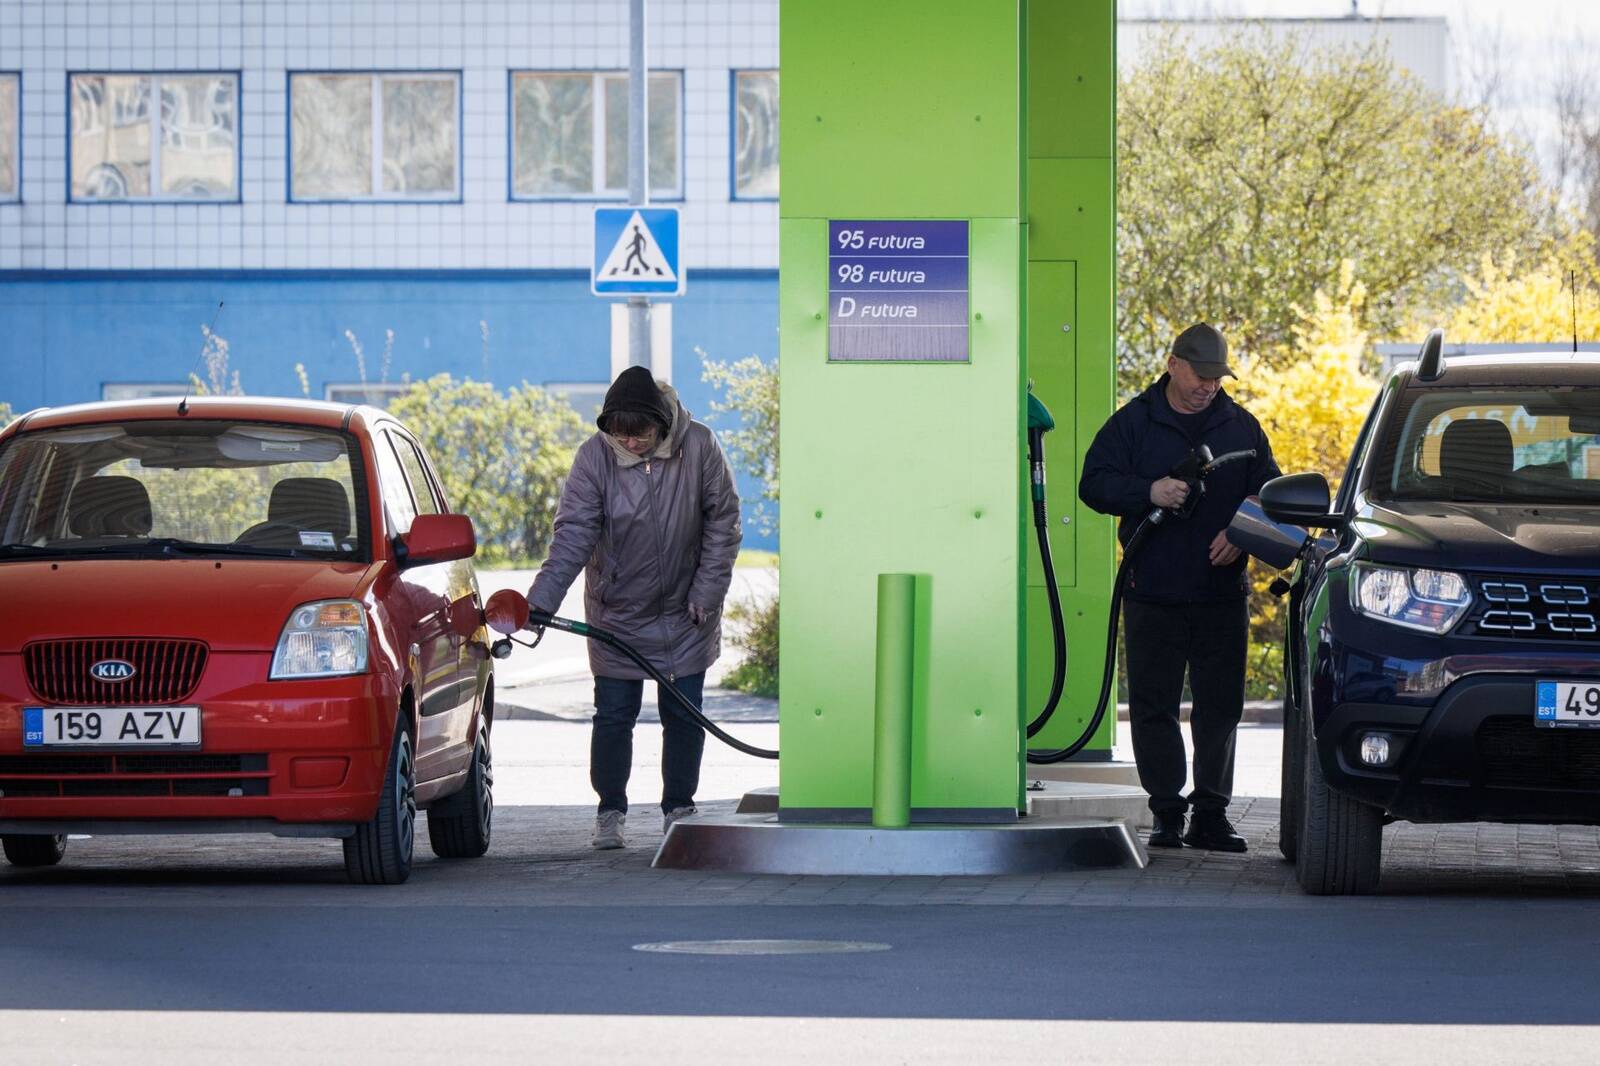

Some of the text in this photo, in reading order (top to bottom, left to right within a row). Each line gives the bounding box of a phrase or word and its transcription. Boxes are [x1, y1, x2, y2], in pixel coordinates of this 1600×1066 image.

[838, 230, 864, 249] 95
[838, 264, 864, 283] 98
[838, 297, 856, 317] D
[98, 665, 128, 676] KIA
[1538, 687, 1600, 716] EST 49
[26, 712, 185, 740] EST 159 AZV
